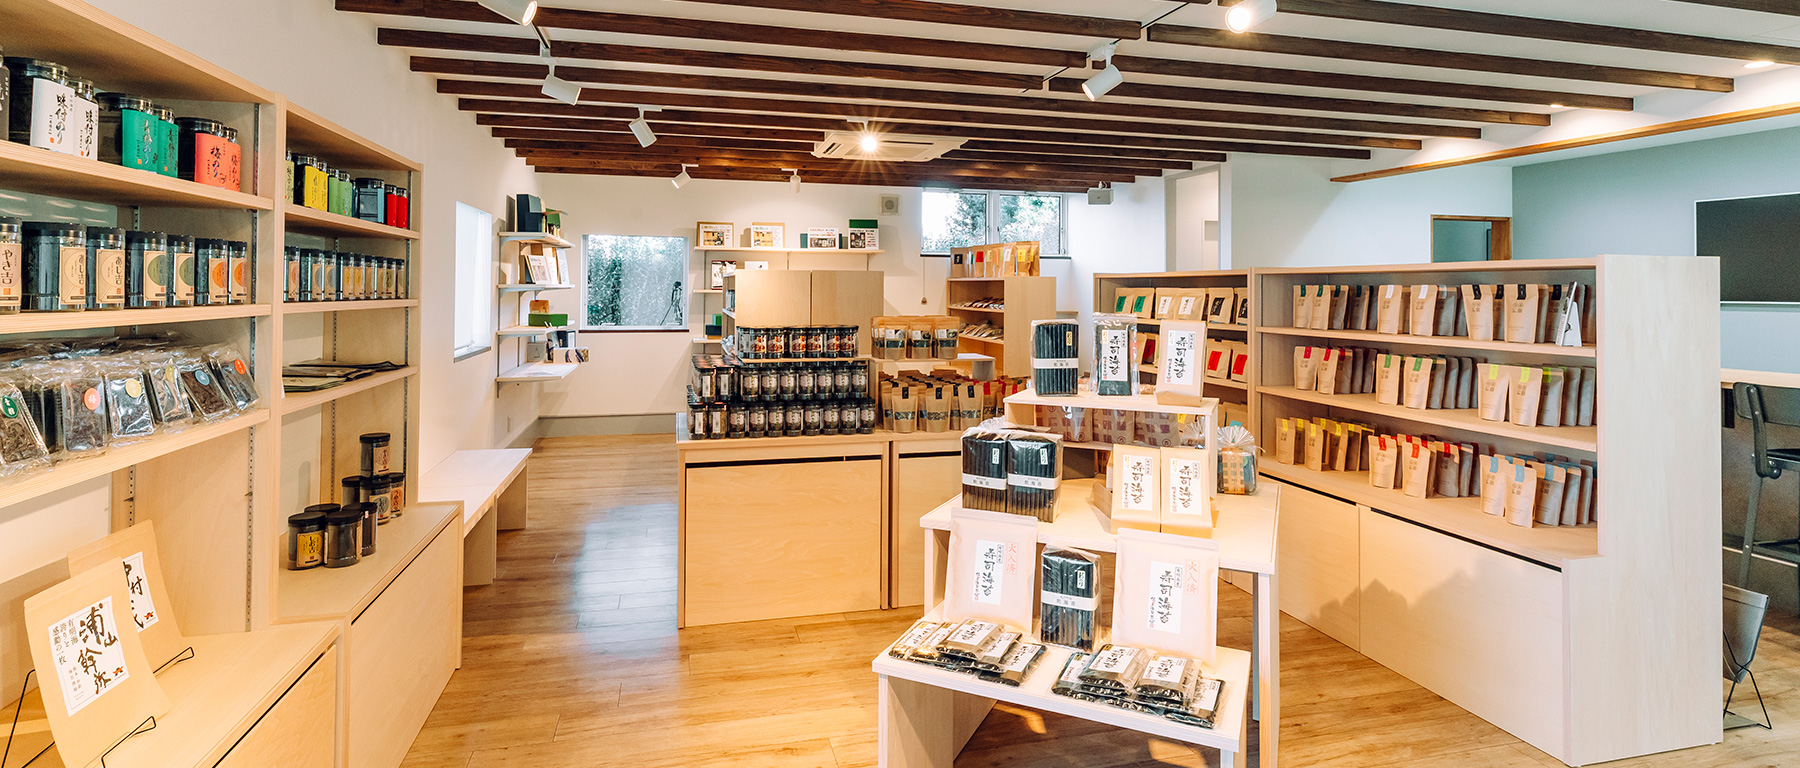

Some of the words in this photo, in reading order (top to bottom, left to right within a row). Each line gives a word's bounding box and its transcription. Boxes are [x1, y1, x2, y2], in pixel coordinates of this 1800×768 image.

[55, 93, 68, 144] 味付のり
[84, 109, 94, 157] 味付のり
[2, 249, 13, 285] やき吉
[1109, 335, 1121, 375] 寿司海苔
[1173, 336, 1188, 378] 寿司海苔
[1131, 461, 1144, 504] 寿司海苔
[1179, 465, 1193, 508] 寿司海苔
[982, 548, 996, 596] 寿司海苔
[1157, 570, 1174, 623] 寿司海苔
[52, 626, 67, 665] 感動の一枚
